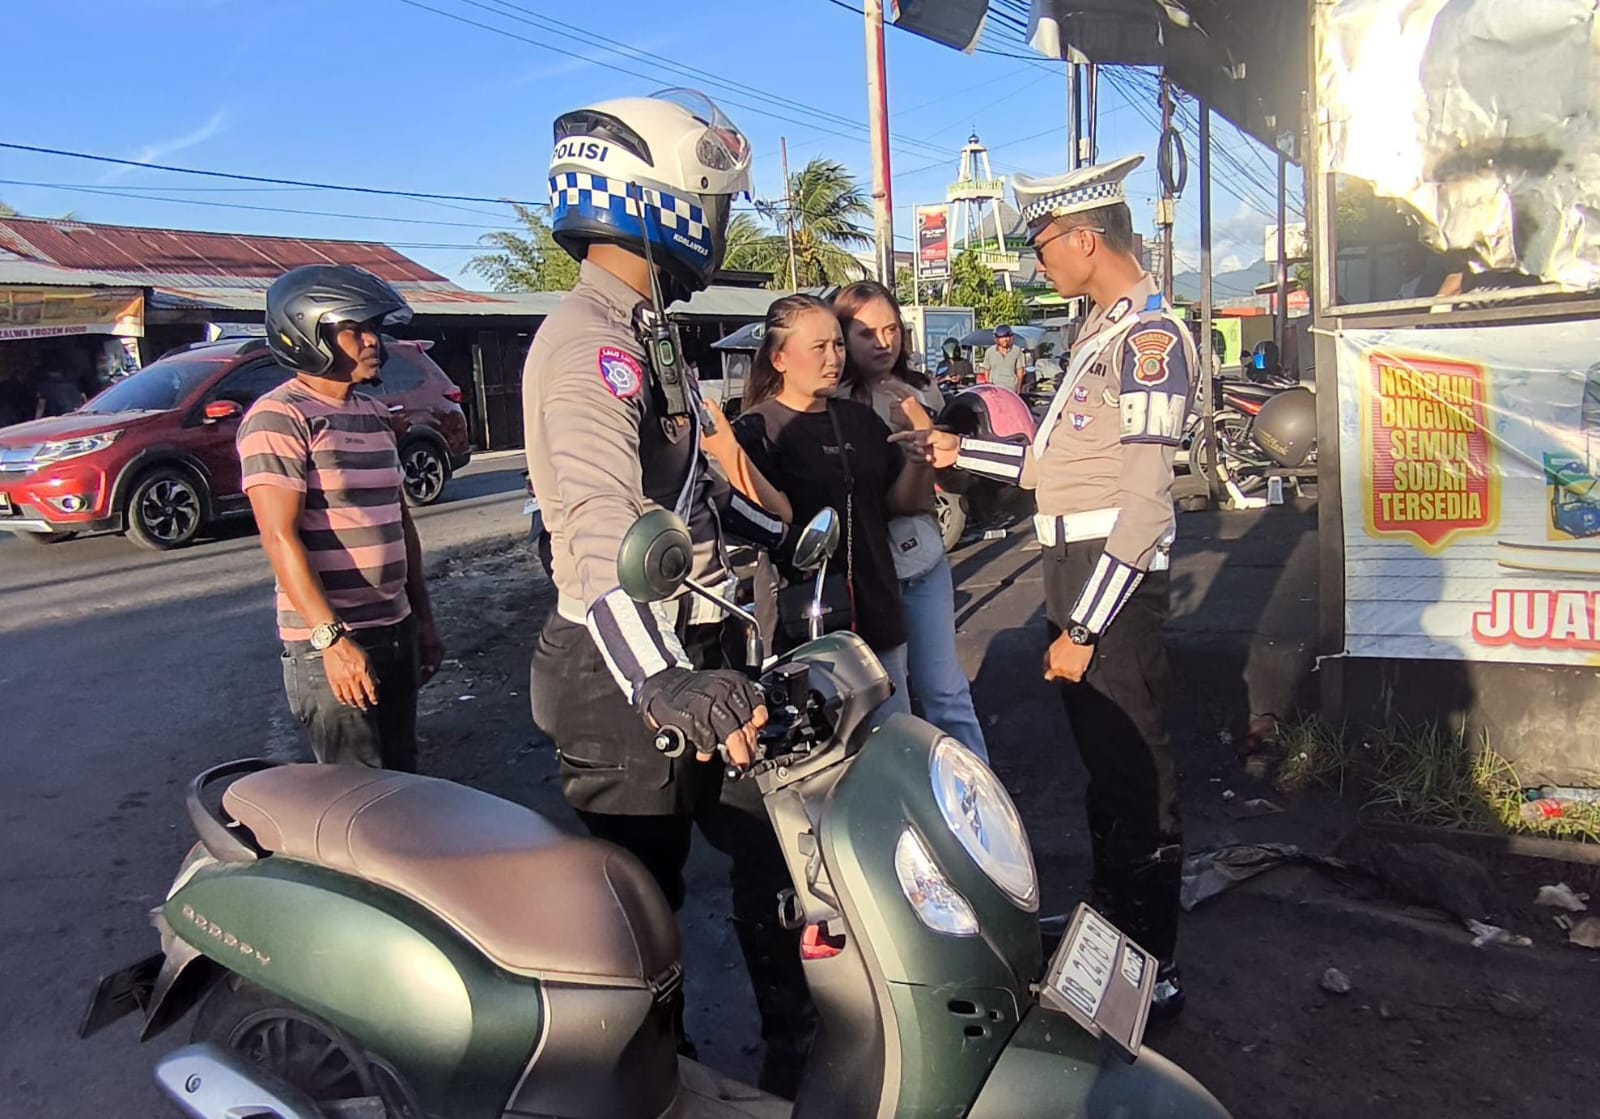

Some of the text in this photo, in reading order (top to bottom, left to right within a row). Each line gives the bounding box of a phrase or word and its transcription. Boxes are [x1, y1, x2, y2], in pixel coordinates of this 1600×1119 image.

[30, 326, 64, 336] FROZEN
[1379, 365, 1473, 405] NGAPAIN
[1380, 397, 1475, 432] BINGUNG
[1390, 429, 1469, 461] SEMUA
[1393, 461, 1468, 492] SUDAH
[1379, 492, 1482, 521] TERSEDIA
[1473, 590, 1600, 645] JUA
